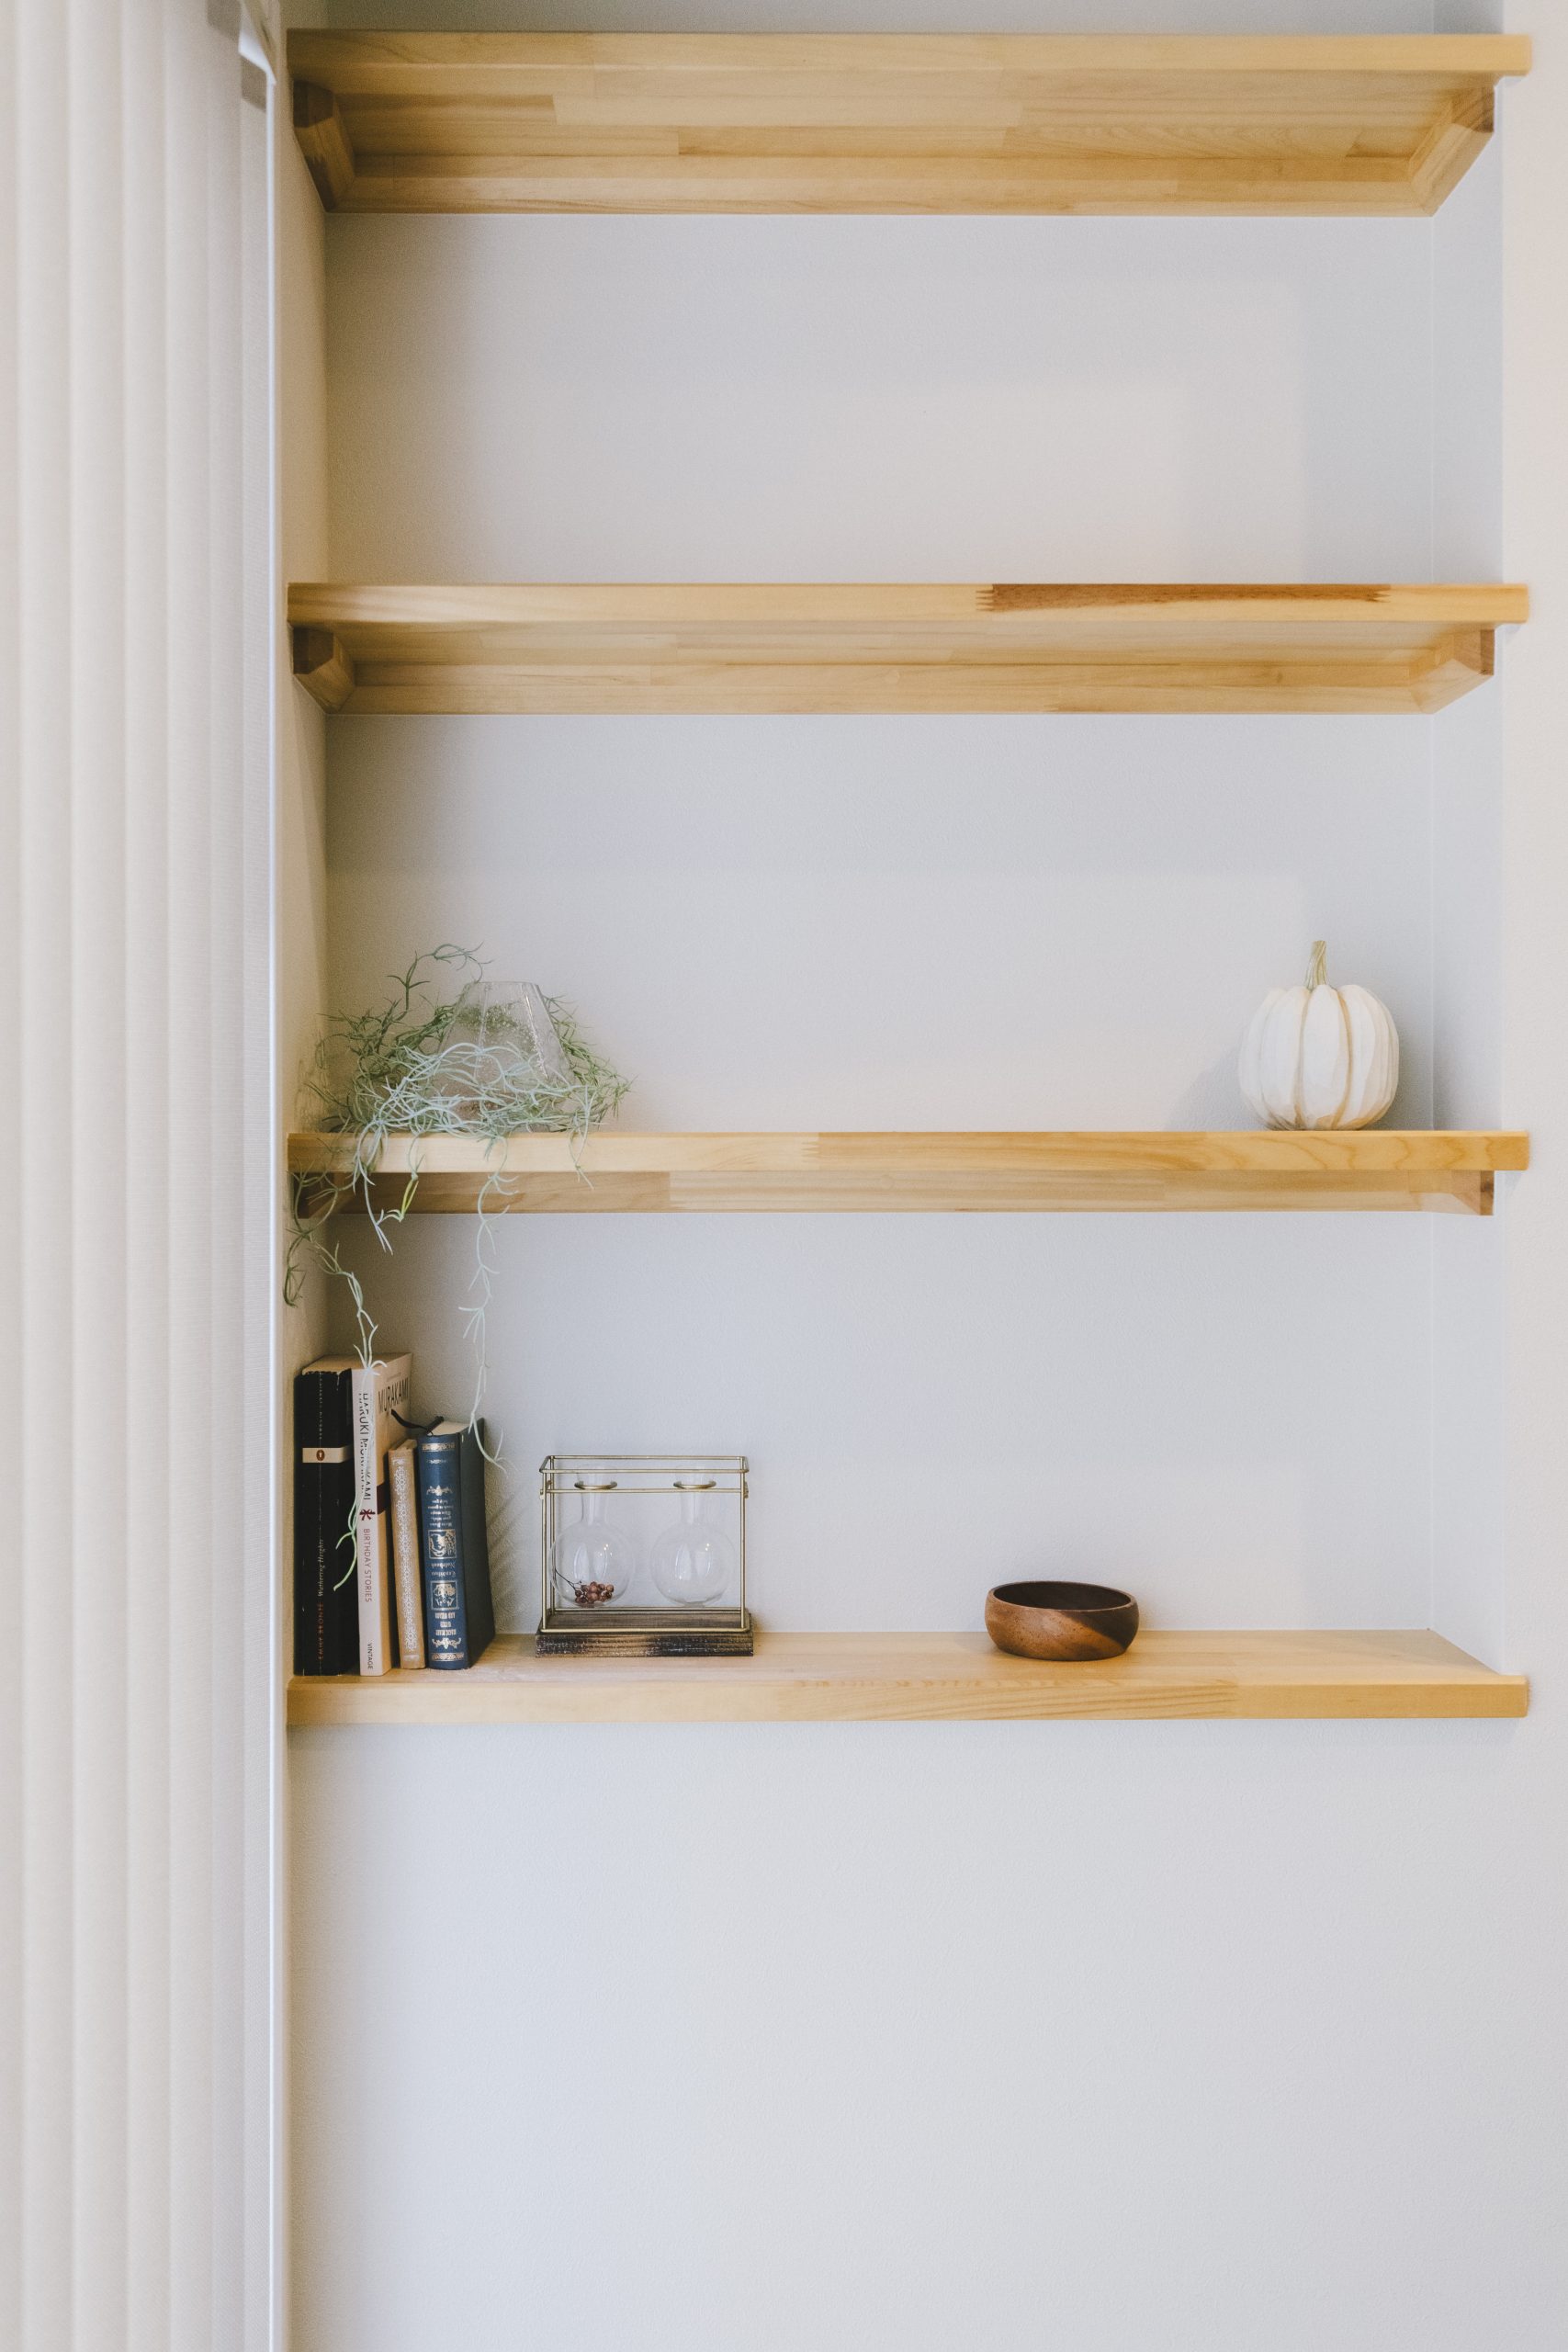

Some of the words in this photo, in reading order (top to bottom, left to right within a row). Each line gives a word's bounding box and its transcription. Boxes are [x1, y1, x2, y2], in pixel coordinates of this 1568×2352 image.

[378, 1377, 409, 1414] MURAKAMI
[358, 1393, 370, 1435] HARUKI
[317, 1538, 326, 1563] Heights
[317, 1565, 326, 1597] Wuthering
[365, 1569, 373, 1602] STORIES
